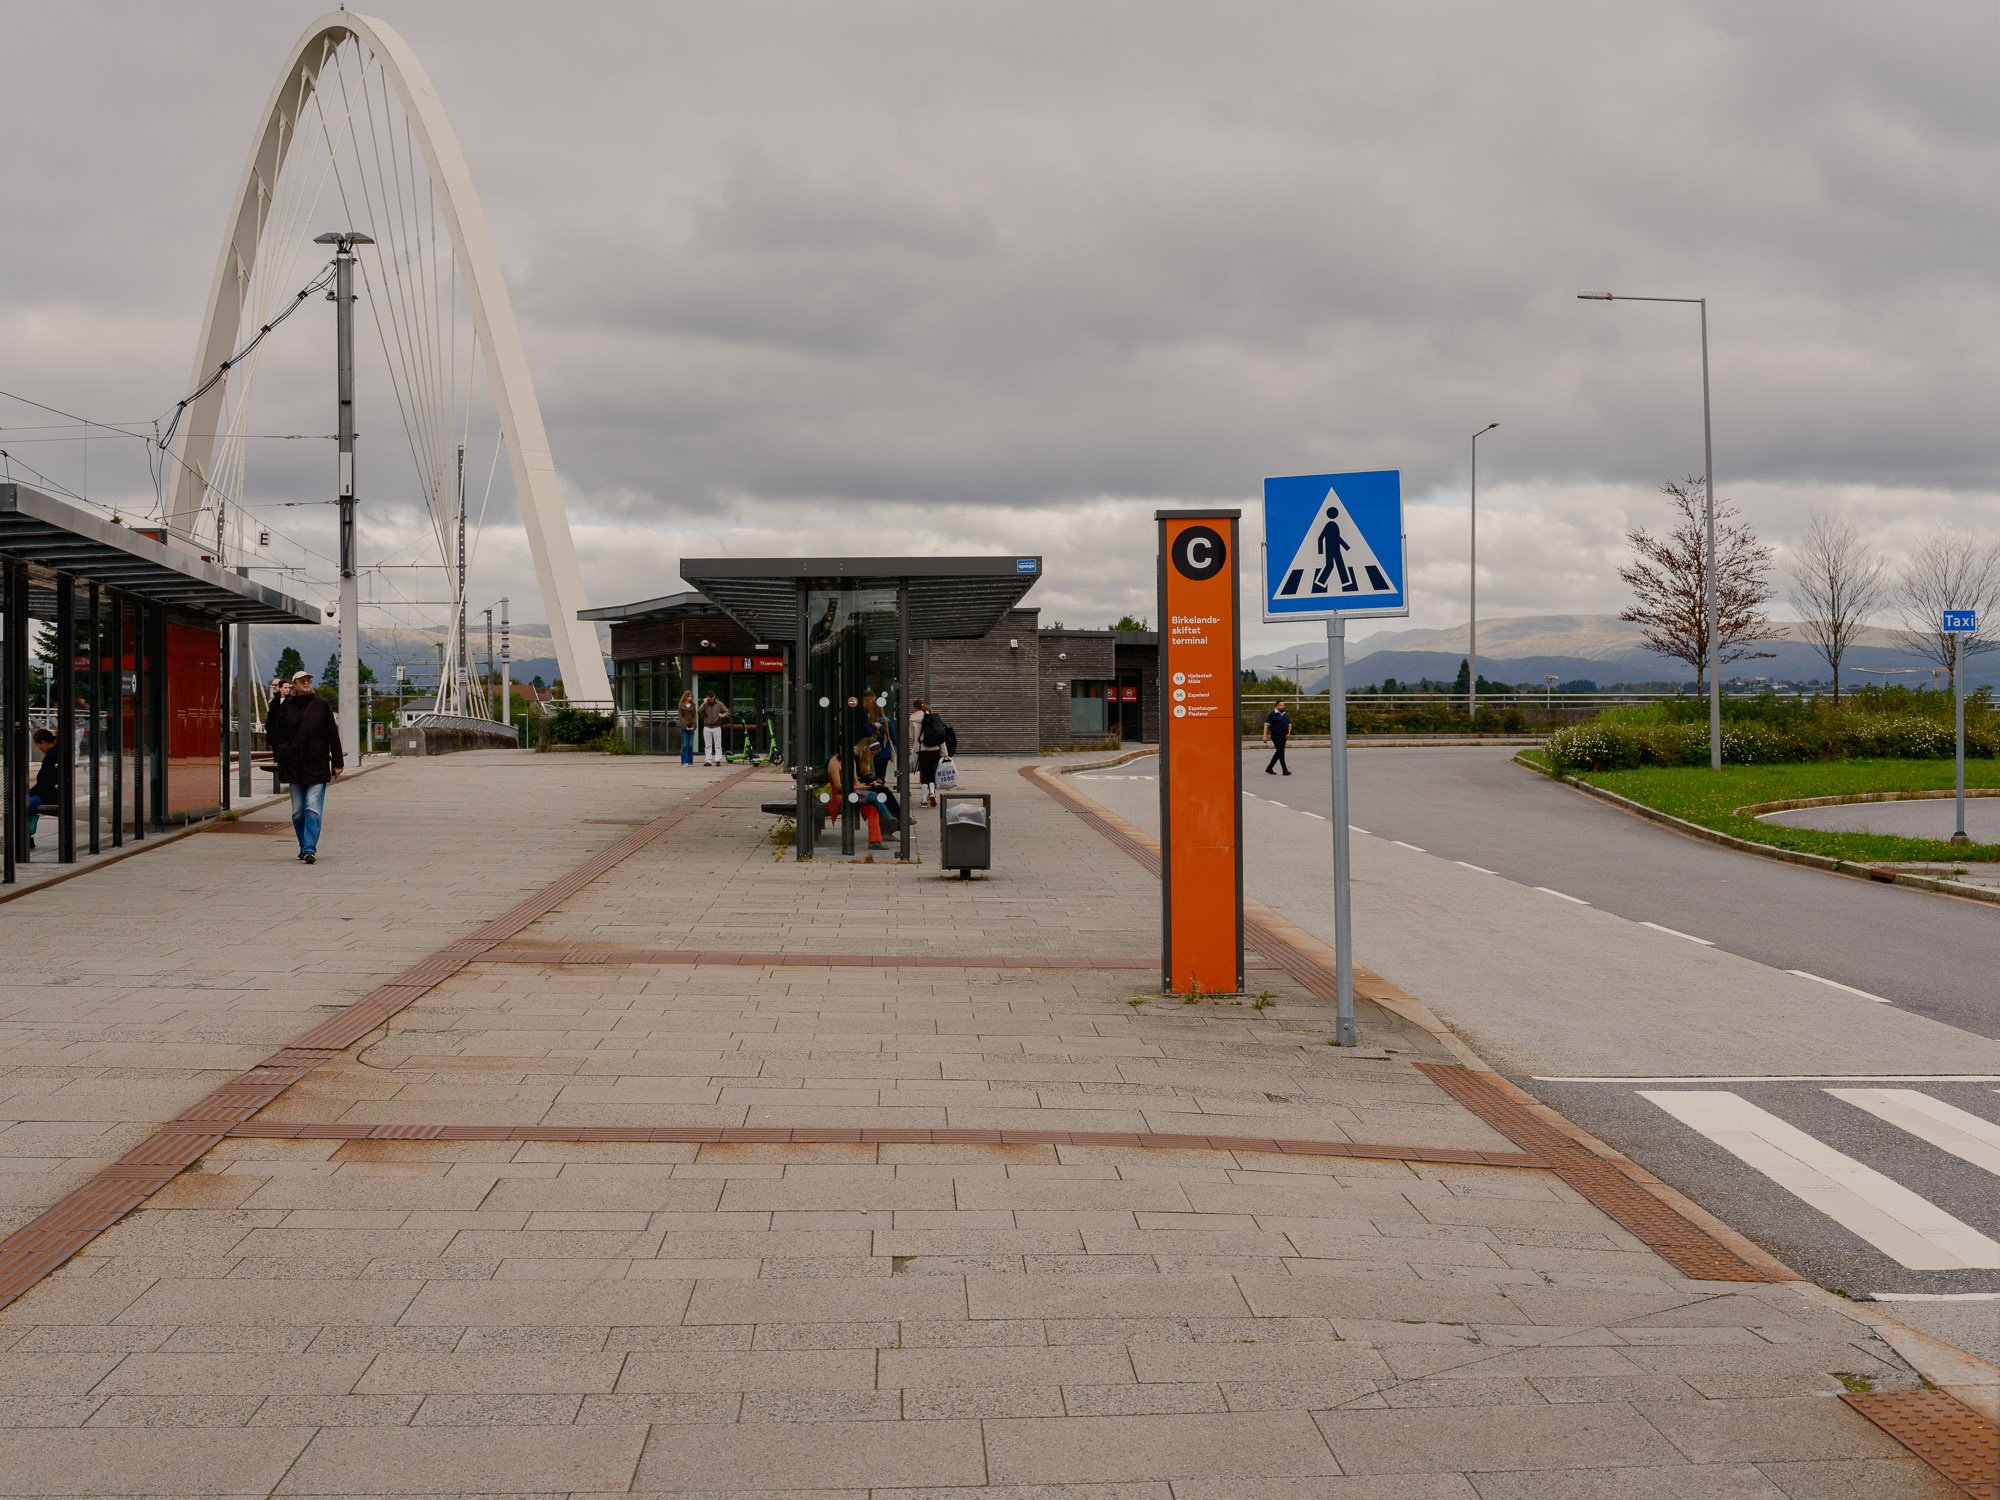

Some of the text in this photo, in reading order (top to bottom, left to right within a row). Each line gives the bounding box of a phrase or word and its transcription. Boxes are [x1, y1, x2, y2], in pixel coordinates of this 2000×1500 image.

[260, 533, 269, 545] E
[1187, 537, 1212, 569] C
[1171, 616, 1220, 624] Birkelands-
[1945, 614, 1974, 627] Taxi
[1171, 626, 1201, 635] skiftet
[1172, 636, 1208, 645] terminal
[937, 769, 956, 777] REMA
[940, 775, 955, 783] 1000
